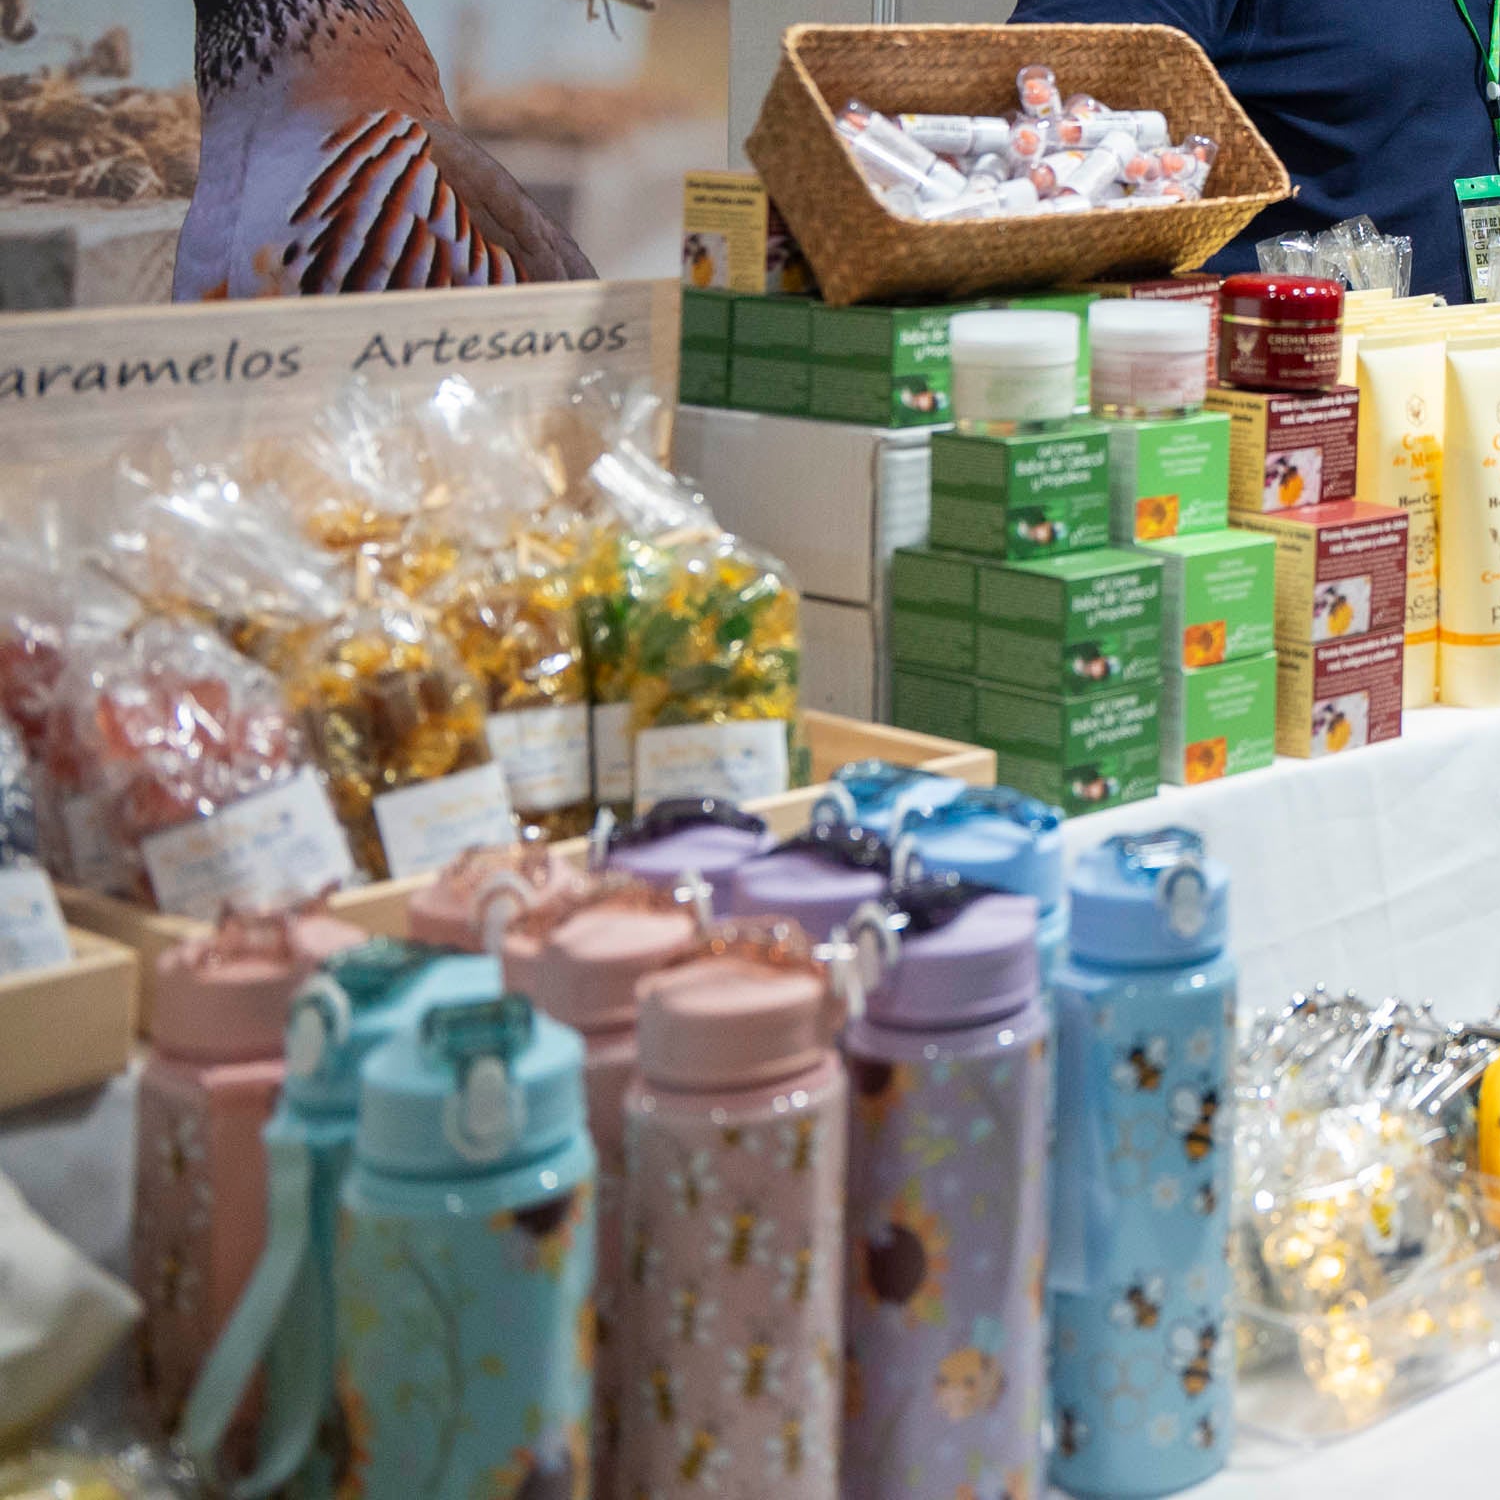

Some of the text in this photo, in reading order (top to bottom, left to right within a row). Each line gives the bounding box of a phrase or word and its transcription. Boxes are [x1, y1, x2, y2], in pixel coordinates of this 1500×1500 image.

[1476, 253, 1488, 265] EX
[0, 321, 628, 400] aramelos Artesanos
